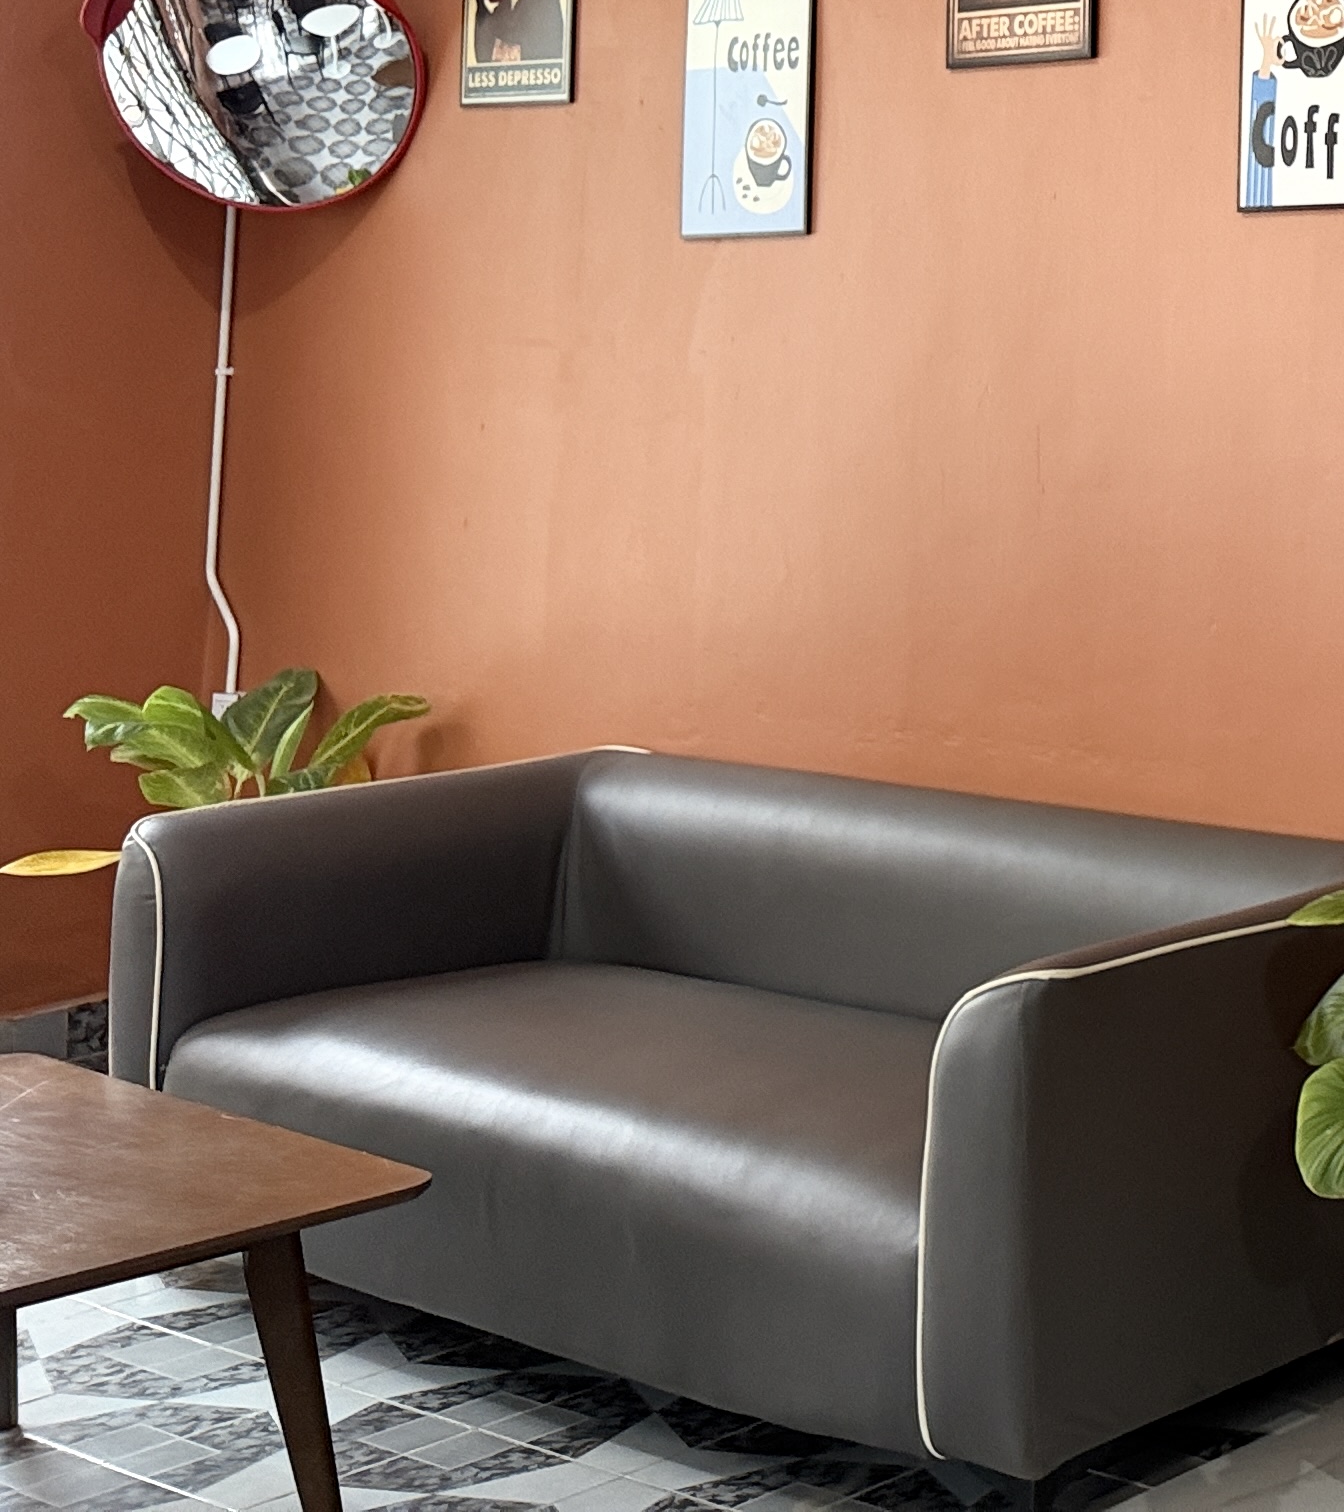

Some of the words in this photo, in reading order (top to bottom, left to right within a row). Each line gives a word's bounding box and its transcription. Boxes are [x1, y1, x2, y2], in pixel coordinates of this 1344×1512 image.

[959, 16, 1010, 40] AFTER
[1013, 10, 1081, 36] COFFEE:
[727, 32, 800, 73] Coffee
[468, 71, 496, 88] LESS
[498, 68, 561, 86] DEPRESSO
